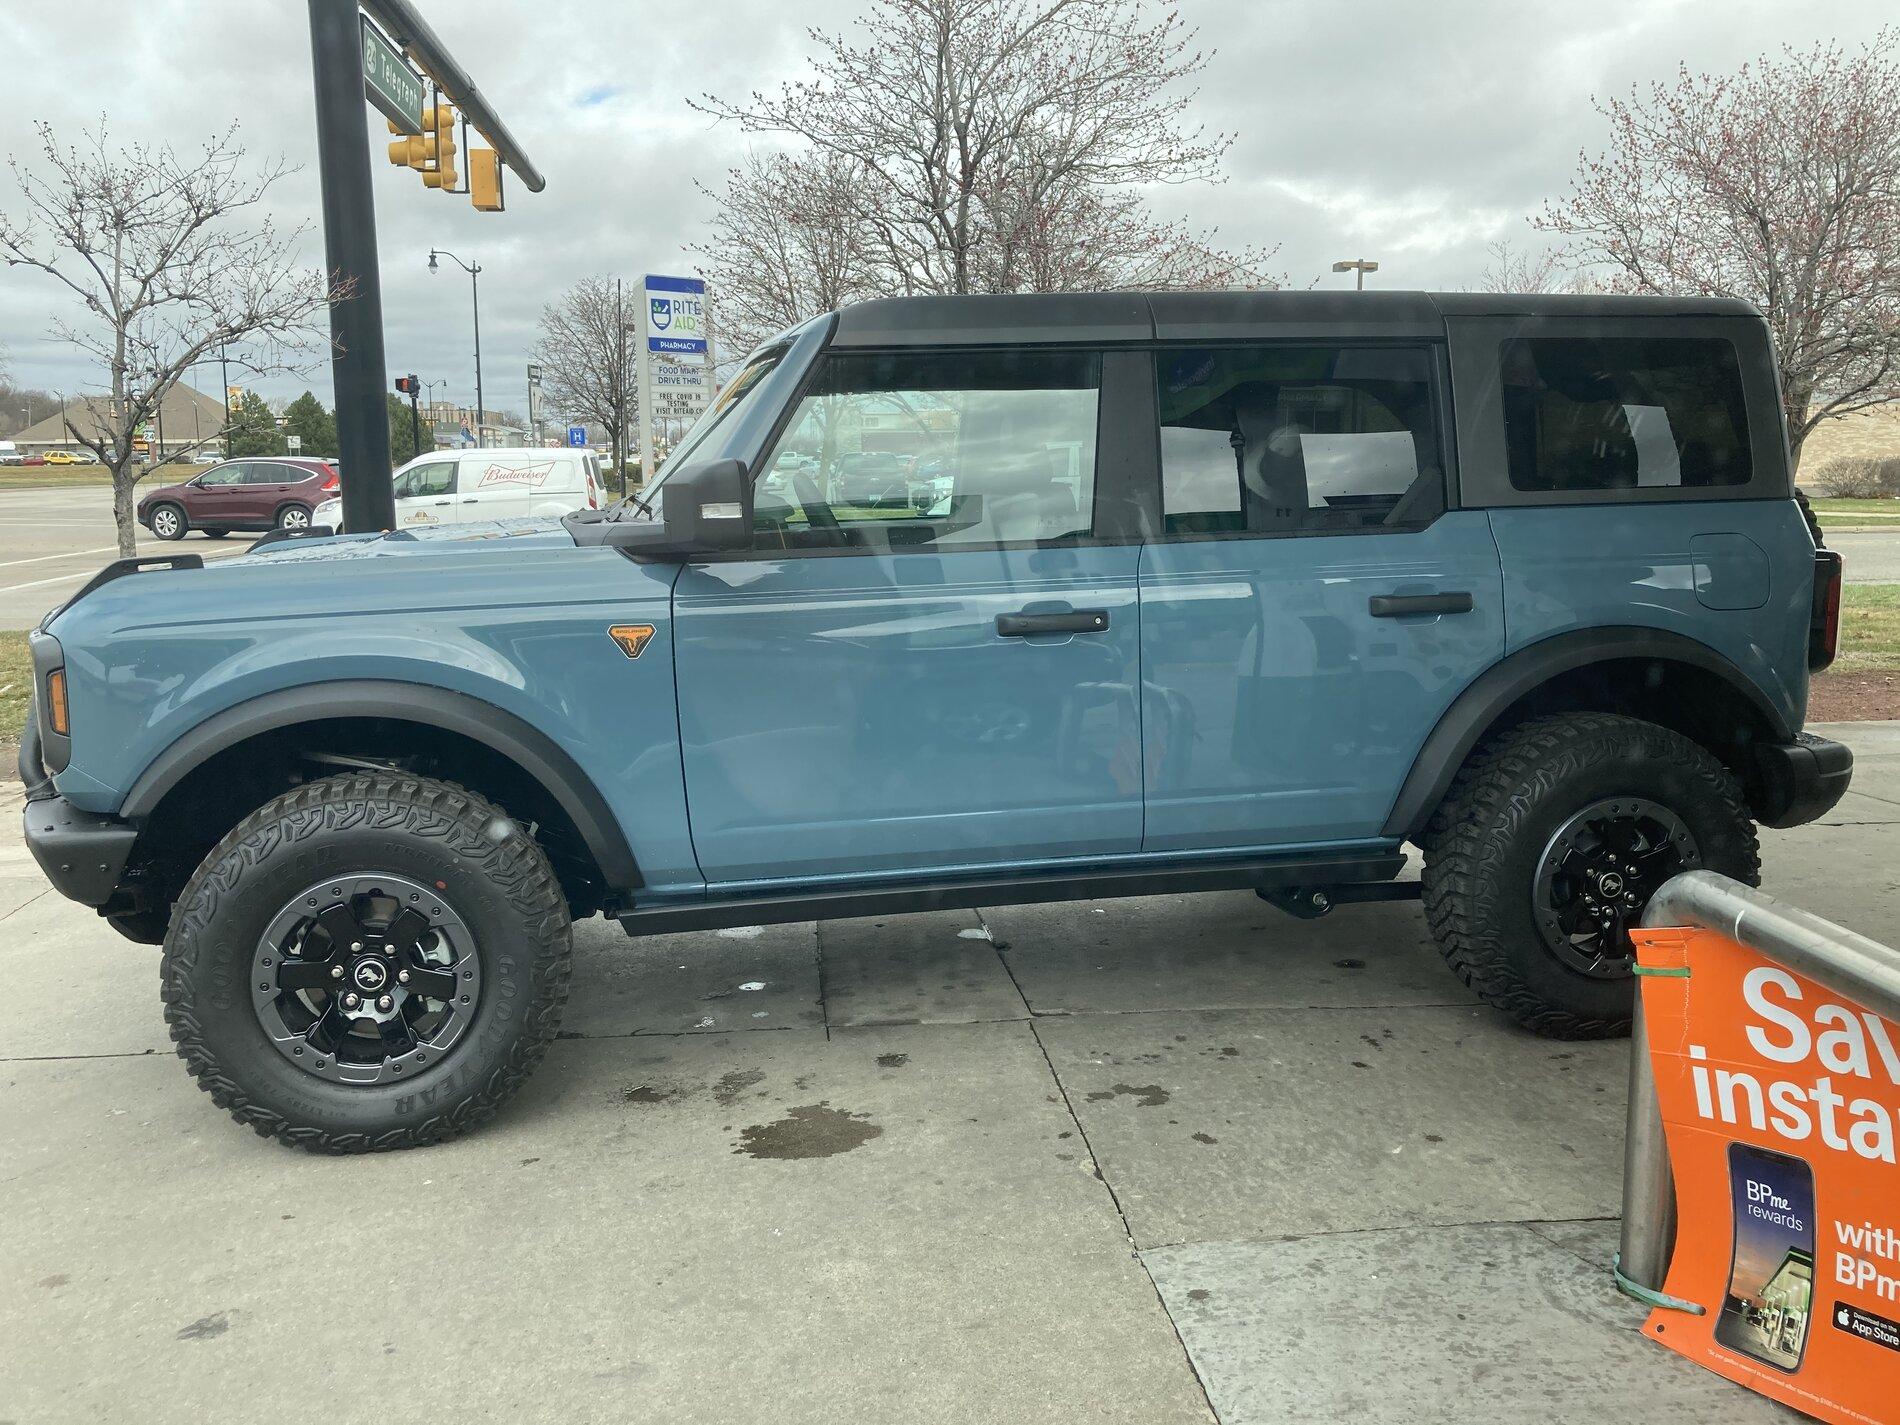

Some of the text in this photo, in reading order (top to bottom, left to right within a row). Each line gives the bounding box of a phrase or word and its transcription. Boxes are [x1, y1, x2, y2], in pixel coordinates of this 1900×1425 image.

[380, 53, 418, 112] Telegraph
[673, 300, 702, 315] RITE
[674, 316, 696, 331] AID
[660, 341, 696, 350] PHARMACY
[658, 366, 679, 375] FOOD
[658, 376, 702, 386] DRIVE THRU
[659, 392, 702, 401] FREE COVID 19
[666, 400, 689, 408] TESTING
[655, 407, 671, 415] VISIT
[144, 433, 154, 441] 24
[574, 432, 581, 440] H
[484, 468, 547, 481] Budweiser
[1689, 1044, 1900, 1164] insta
[1746, 1179, 1792, 1211] BPme
[1748, 1203, 1803, 1232] rewards
[1834, 1220, 1900, 1263] with
[1835, 1251, 1900, 1304] BPm
[1853, 1311, 1898, 1334] Download on the
[1851, 1319, 1900, 1346] App Store
